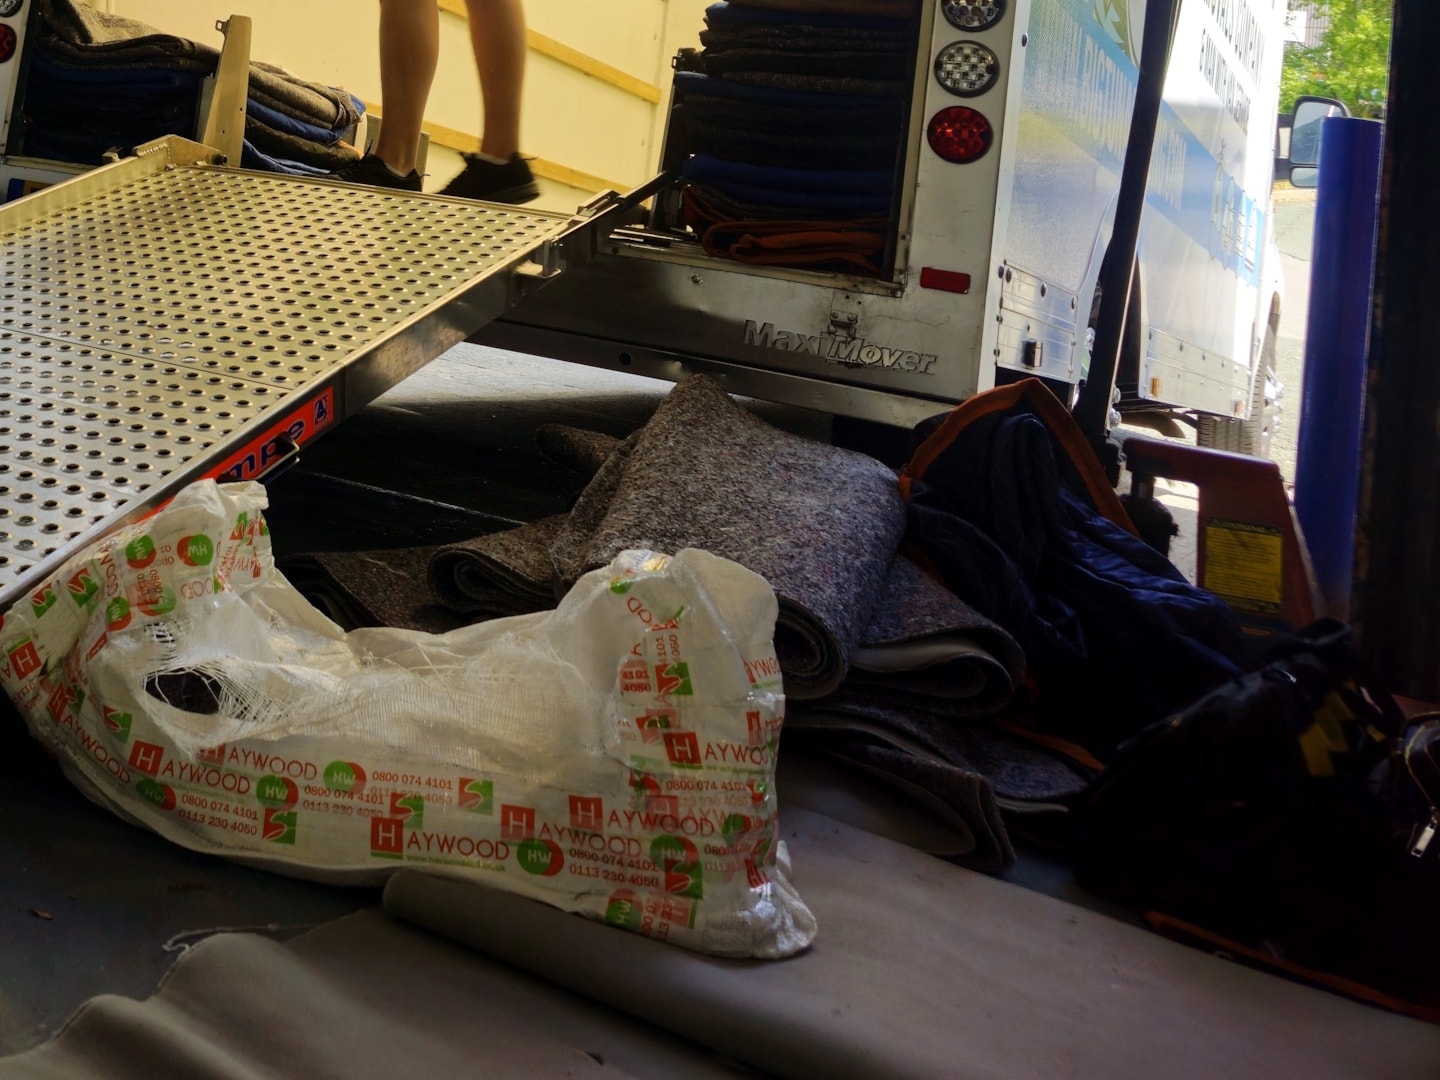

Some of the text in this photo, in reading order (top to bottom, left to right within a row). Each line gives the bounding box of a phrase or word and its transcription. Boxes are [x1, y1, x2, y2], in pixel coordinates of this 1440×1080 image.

[744, 319, 938, 374] MaxiMover
[134, 745, 251, 795] HAYWOOD
[333, 770, 357, 786] HW
[372, 771, 453, 790] 0800 074 4101
[265, 785, 289, 800] HW
[304, 785, 384, 806] 0800 074 4101
[666, 780, 693, 791] 0800
[696, 780, 717, 791] 074
[182, 794, 208, 809] 0800
[210, 799, 230, 813] 074
[233, 805, 258, 820] 4101
[332, 804, 353, 816] 230
[578, 801, 715, 837] HAYWOOD
[179, 809, 257, 835] 0113 230 4050
[509, 808, 642, 858] HAYWOOD
[377, 822, 509, 860] HAYWOOD
[527, 850, 552, 865] HW
[569, 848, 658, 871] 0800 074 4101
[569, 863, 659, 888] 0113 230 4050
